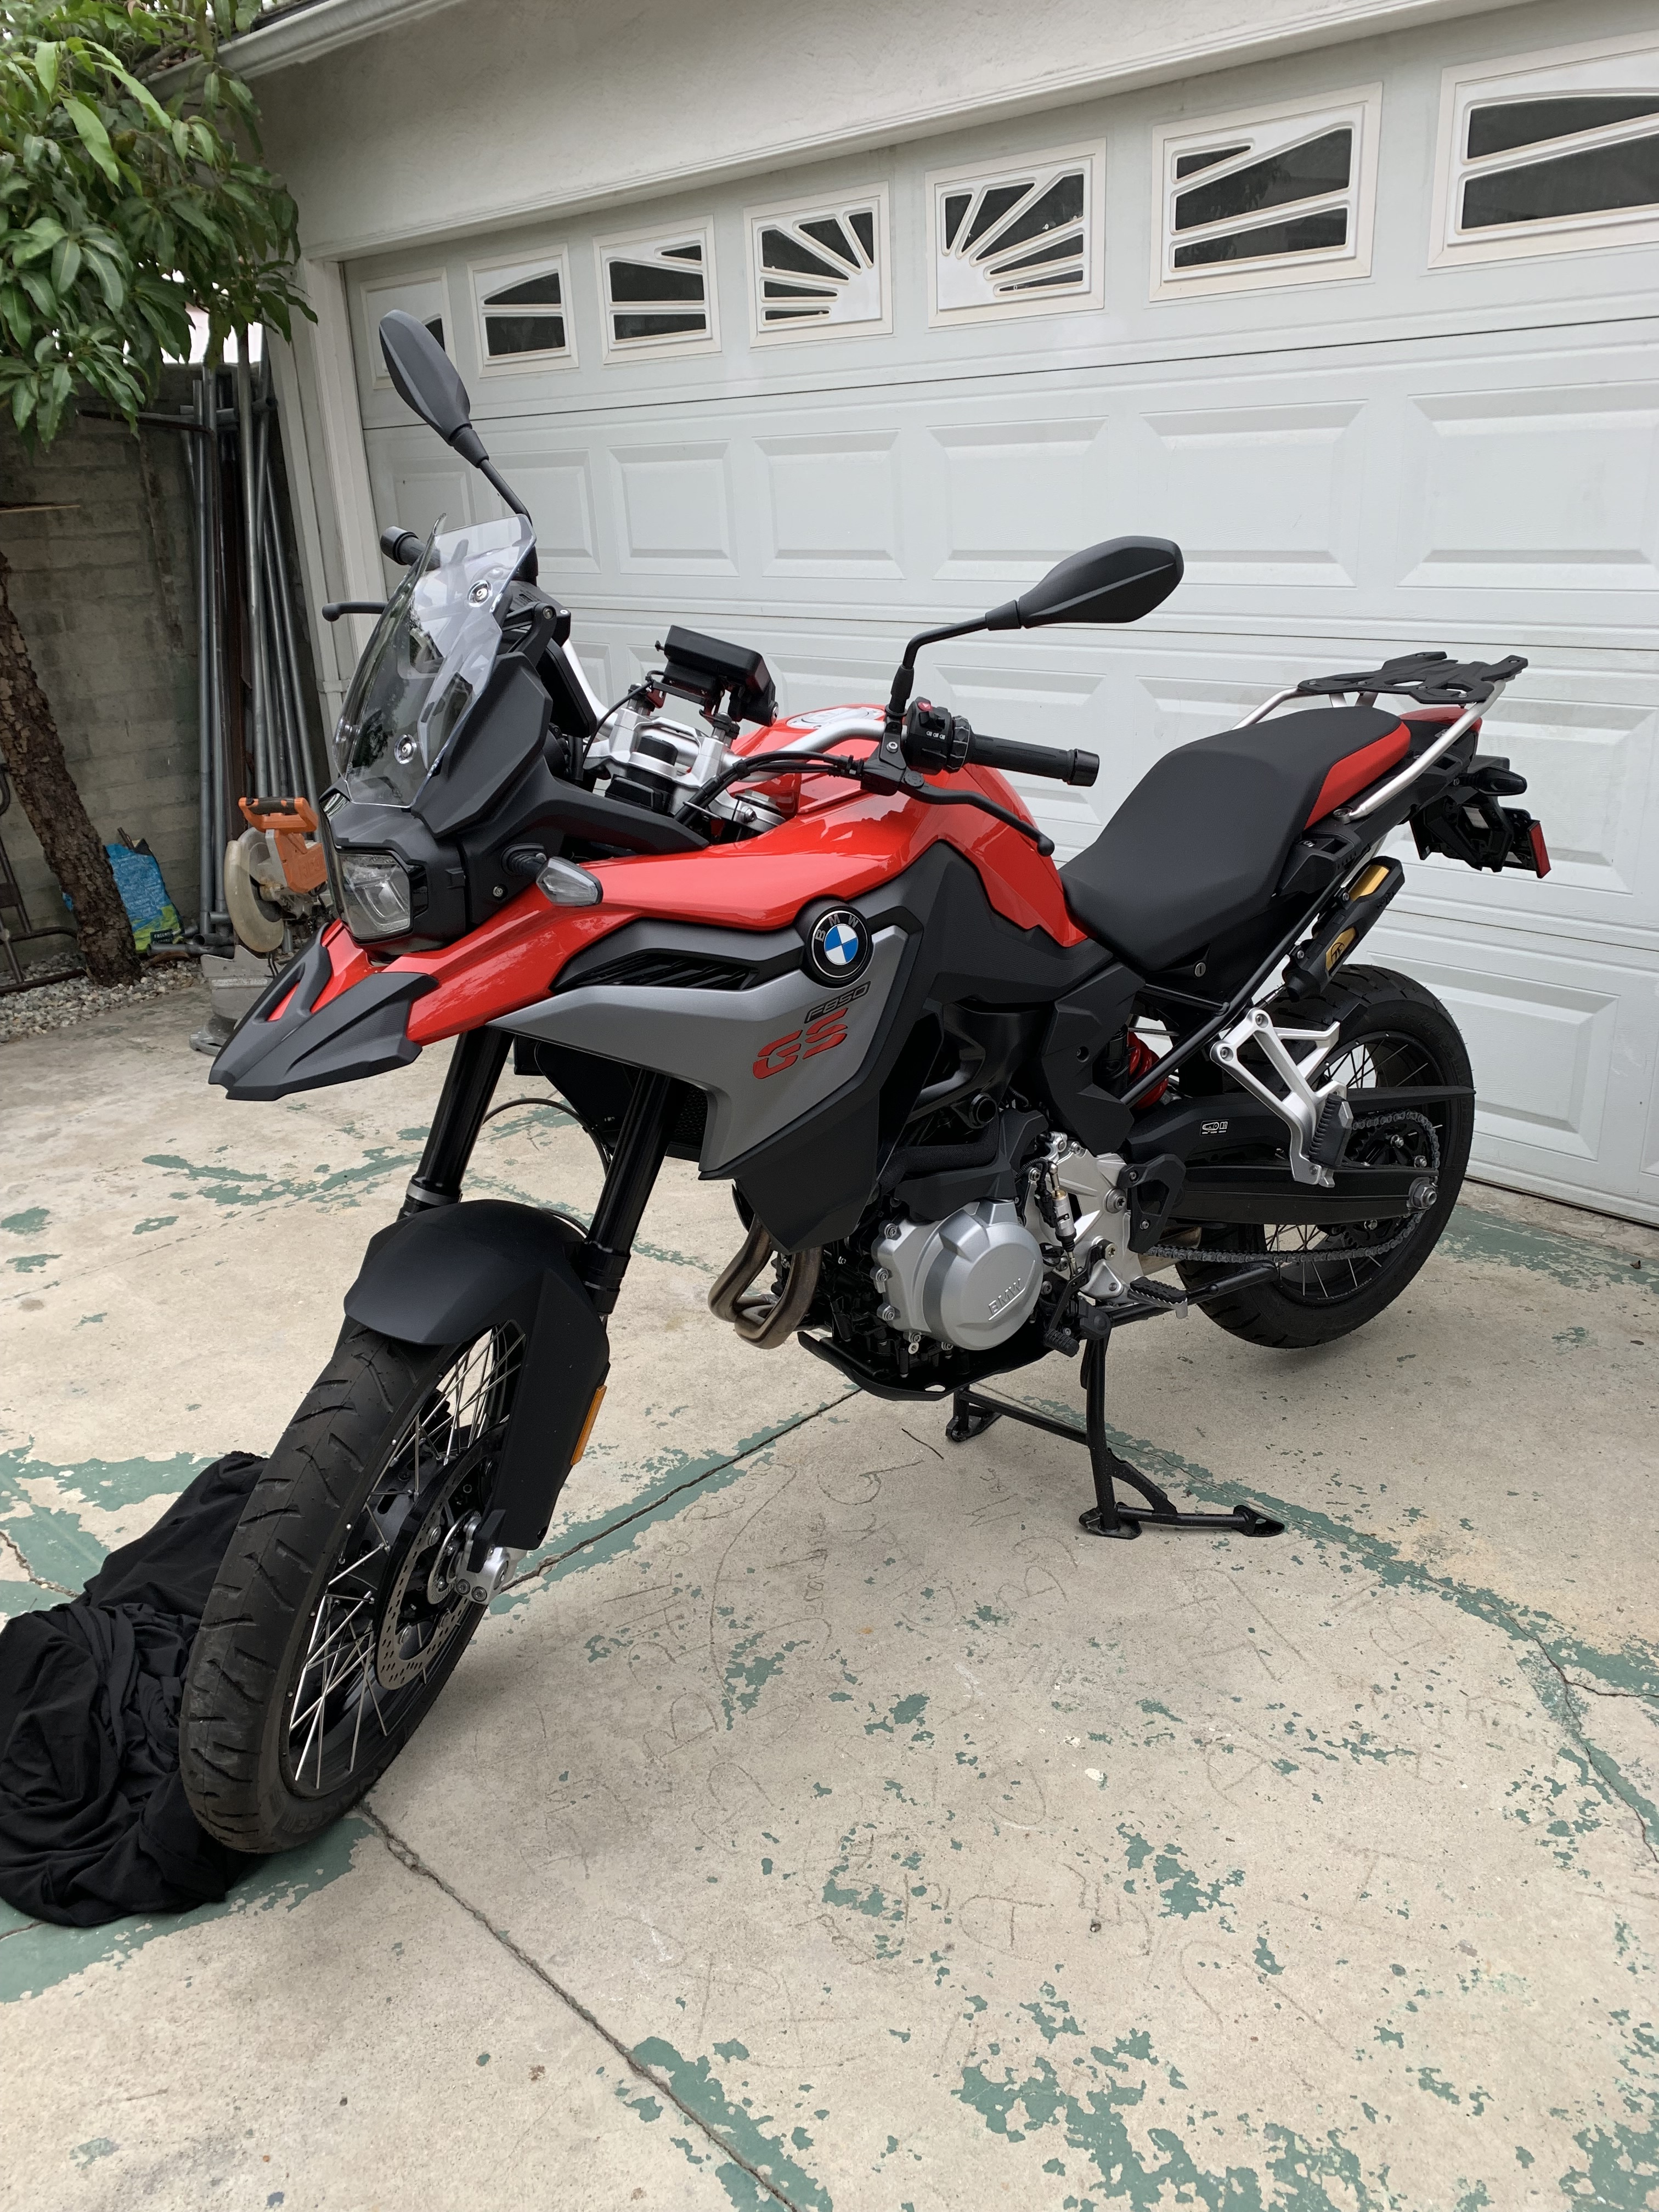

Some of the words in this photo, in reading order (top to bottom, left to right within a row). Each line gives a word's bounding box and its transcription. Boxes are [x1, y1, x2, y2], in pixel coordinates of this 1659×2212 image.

[815, 913, 859, 942] BMW
[806, 984, 868, 1022] F850
[753, 1007, 848, 1079] GS
[989, 1278, 1022, 1315] BMW
